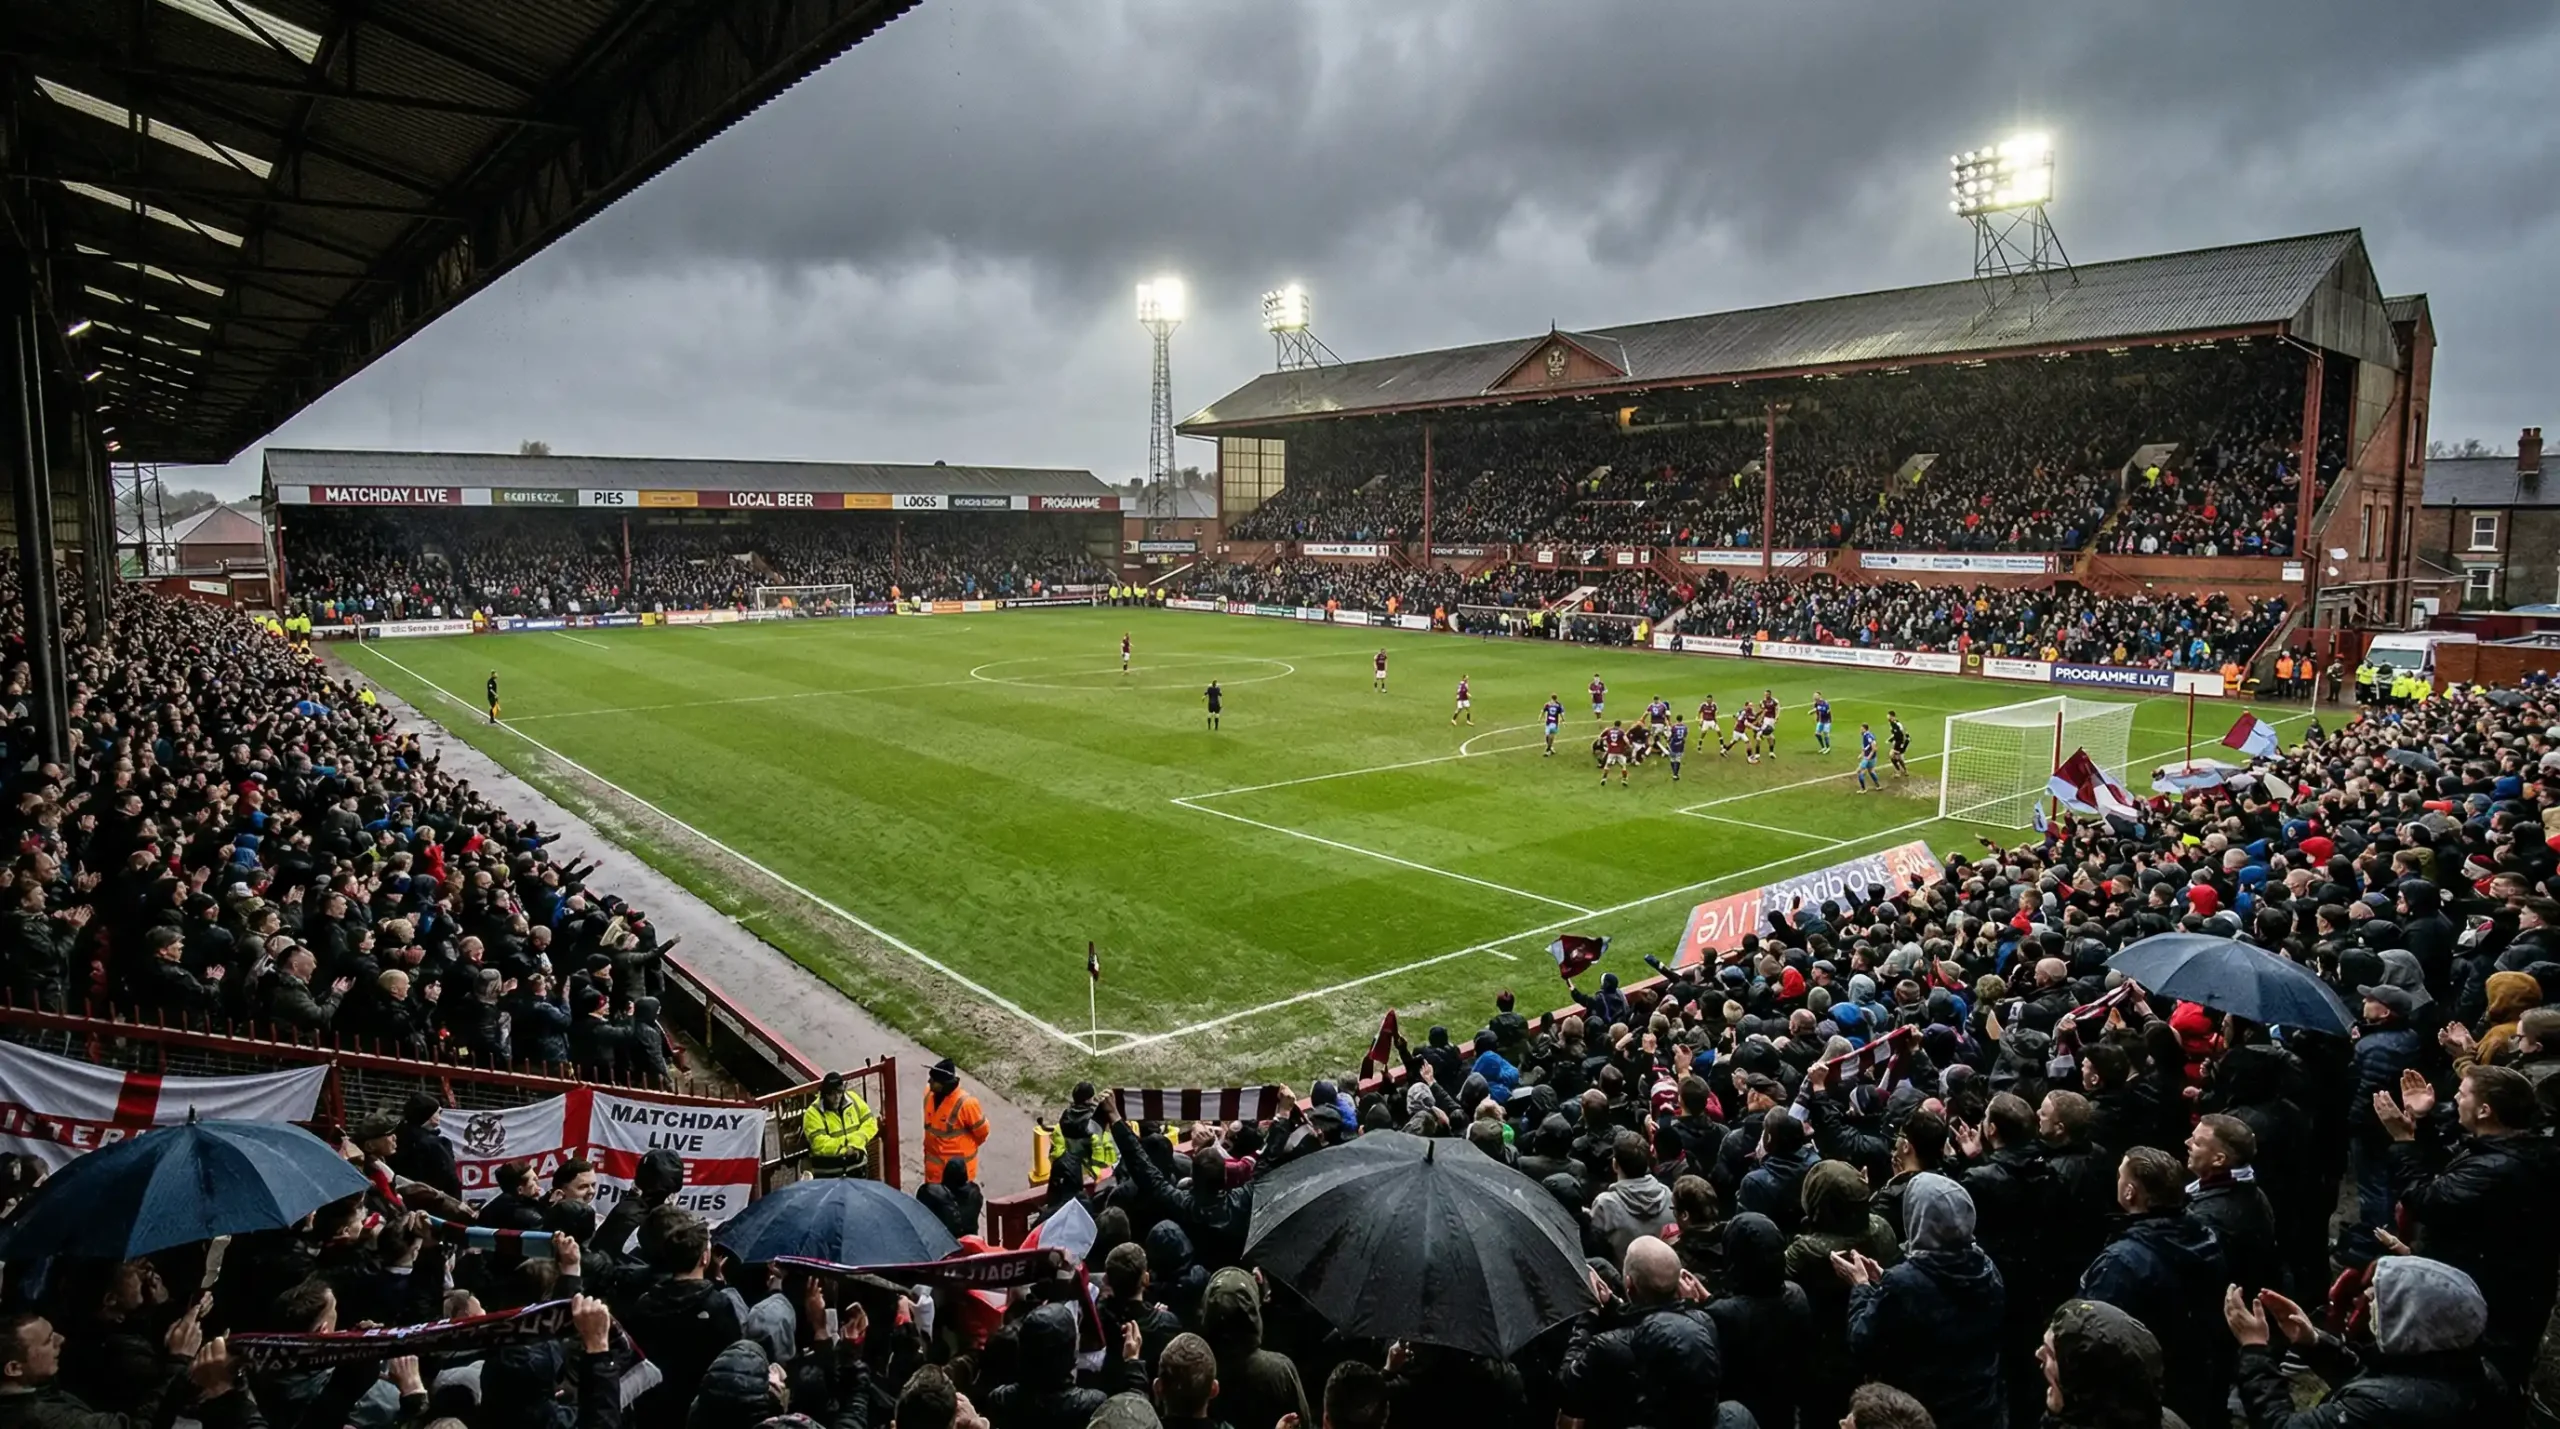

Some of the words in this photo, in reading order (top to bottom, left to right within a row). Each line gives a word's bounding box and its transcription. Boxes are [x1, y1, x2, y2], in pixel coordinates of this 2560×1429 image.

[325, 487, 410, 502] MATCHDAY
[415, 488, 448, 502] LIVE
[594, 492, 624, 504] PIES
[729, 492, 775, 507] LOCAL
[778, 493, 814, 507] BEER
[2055, 667, 2138, 684] PROGRAMME
[2141, 673, 2170, 687] LIVE
[610, 1103, 744, 1130] MATCHDAY
[648, 1131, 704, 1152] LIVE
